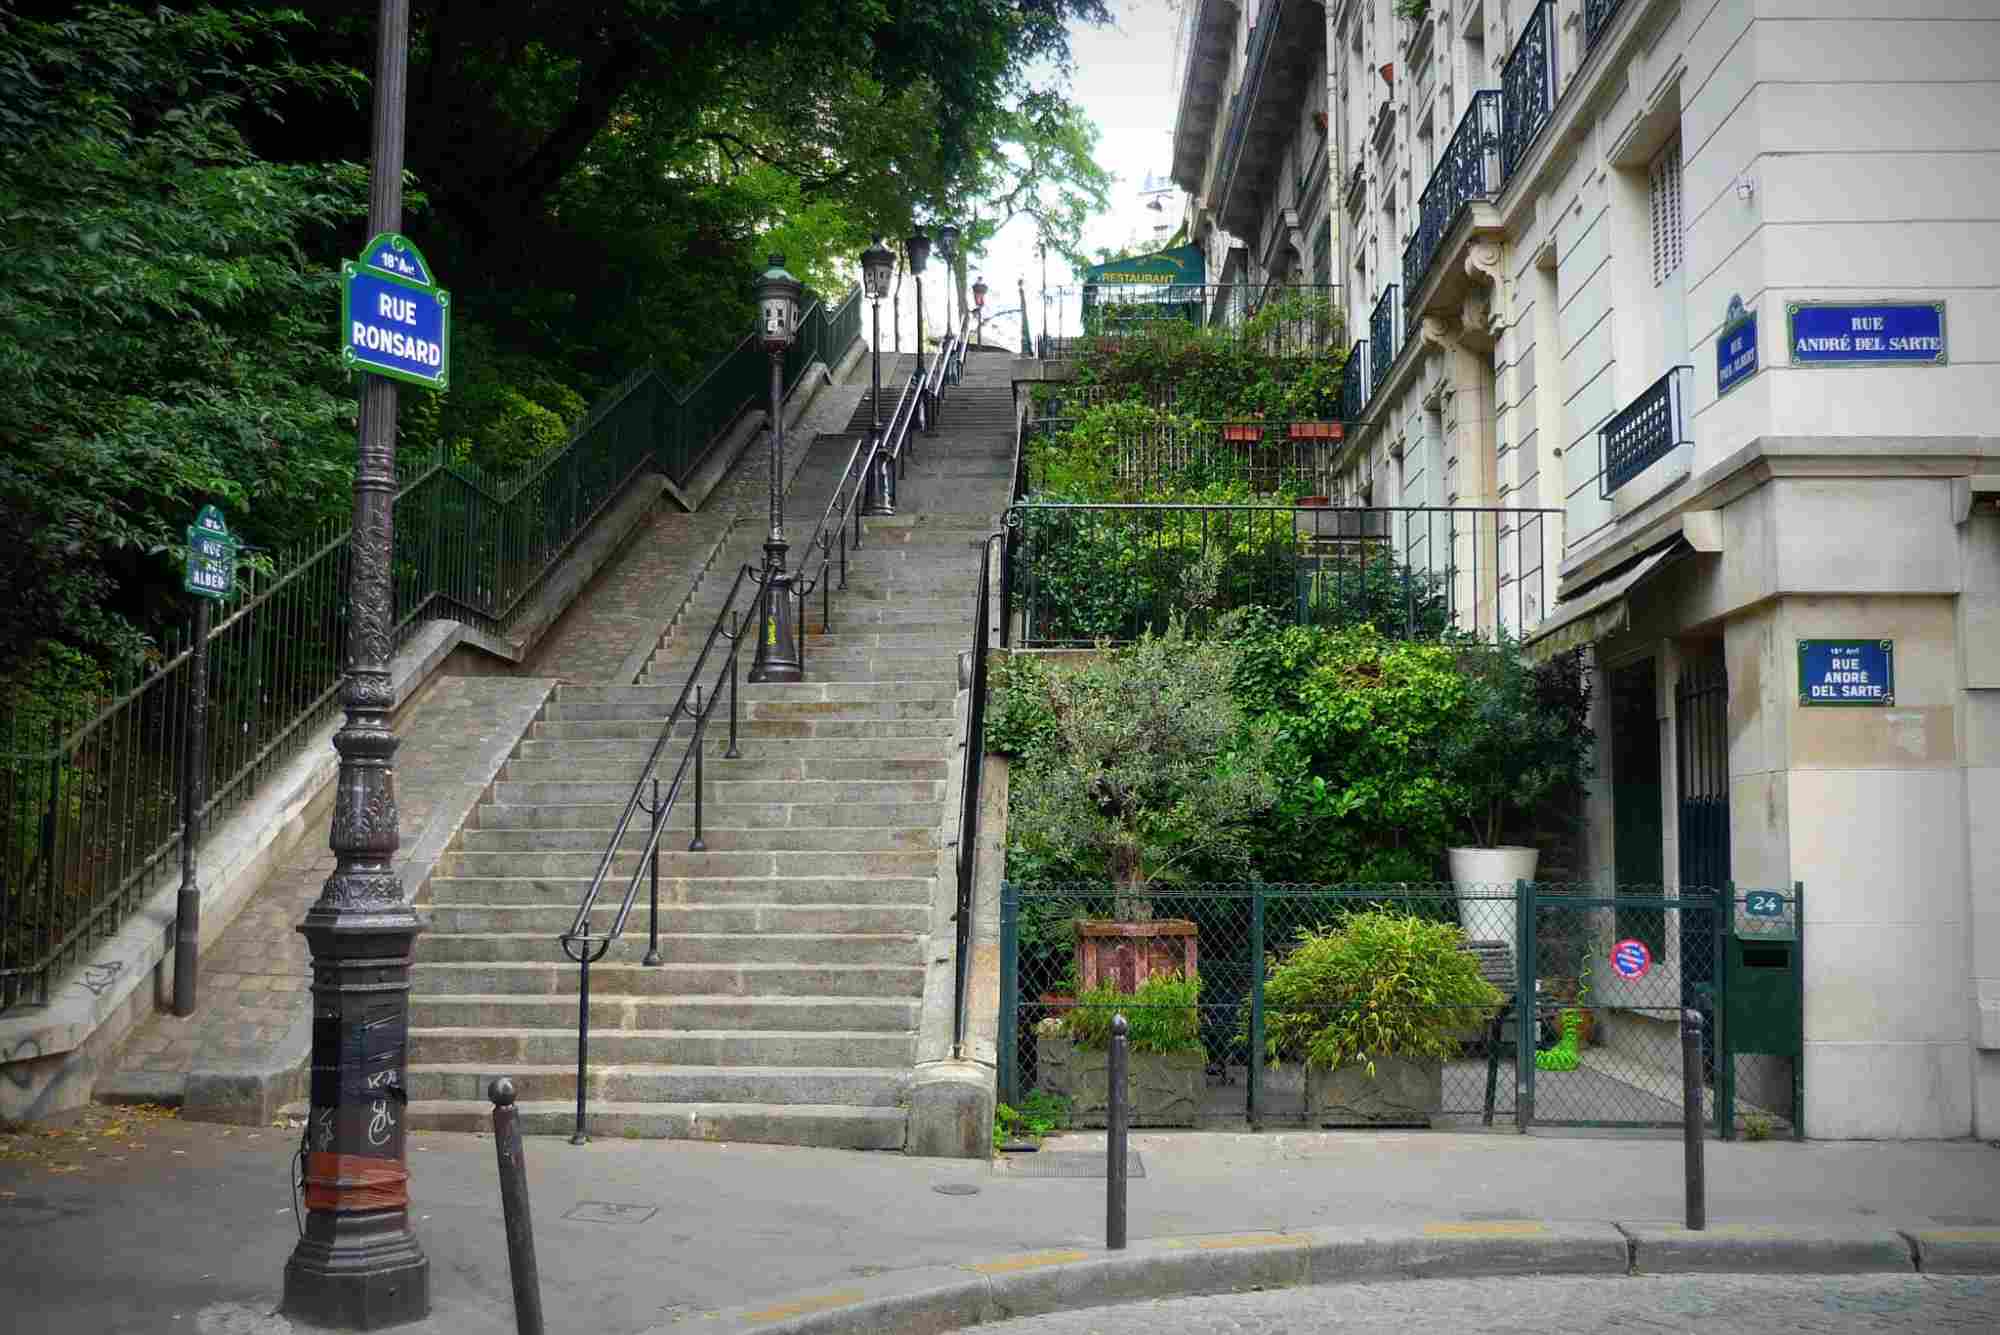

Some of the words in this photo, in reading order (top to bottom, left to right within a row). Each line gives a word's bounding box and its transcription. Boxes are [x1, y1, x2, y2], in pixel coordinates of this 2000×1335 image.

[1103, 271, 1176, 283] RESTAURANT
[379, 292, 417, 326] RUE
[1851, 316, 1884, 331] RUE
[352, 321, 441, 367] RONSARD
[1796, 334, 1851, 352] ANDRÉ
[1855, 337, 1885, 351] DEL
[1889, 336, 1941, 351] SARTE
[1832, 658, 1860, 670] RUE
[1824, 670, 1870, 683] ANDRÉ
[1811, 685, 1837, 697] DEL
[1841, 685, 1882, 697] SARTE
[1753, 896, 1776, 911] 24
